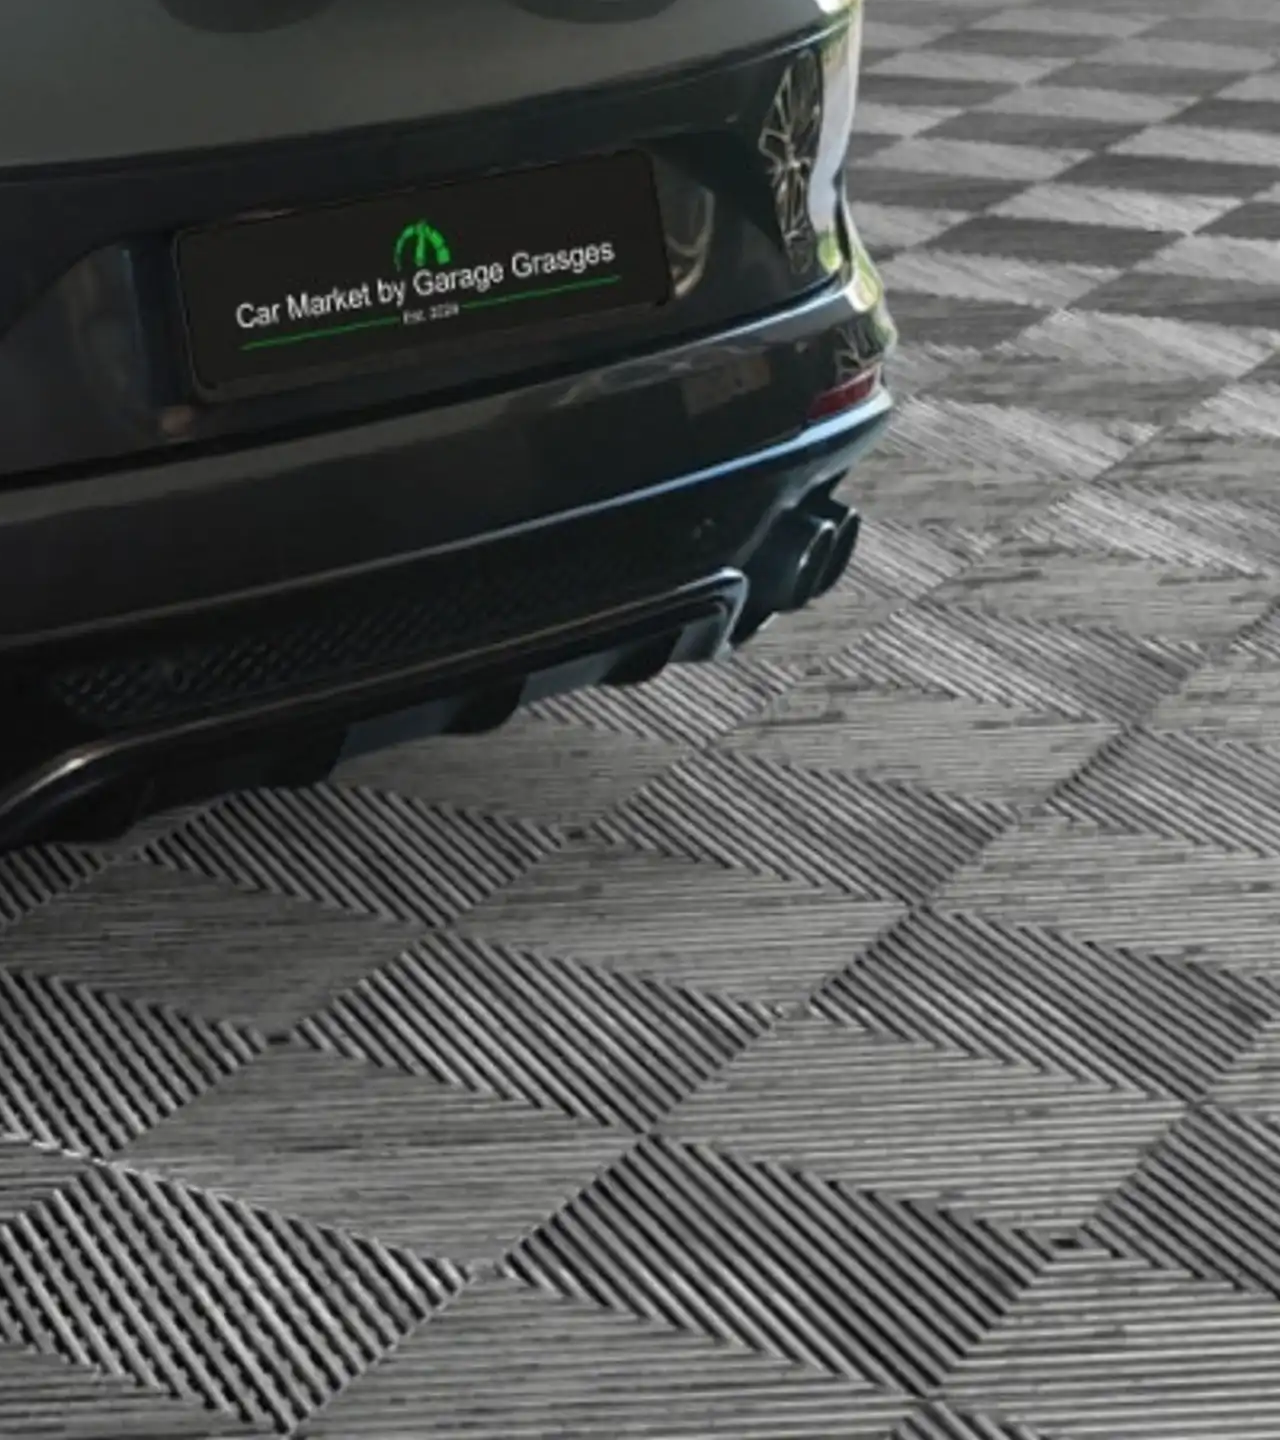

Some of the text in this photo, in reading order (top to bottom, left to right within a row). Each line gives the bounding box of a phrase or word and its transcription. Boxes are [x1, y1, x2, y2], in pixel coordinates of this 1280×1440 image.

[235, 241, 616, 330] Car Market by Garage Grasges
